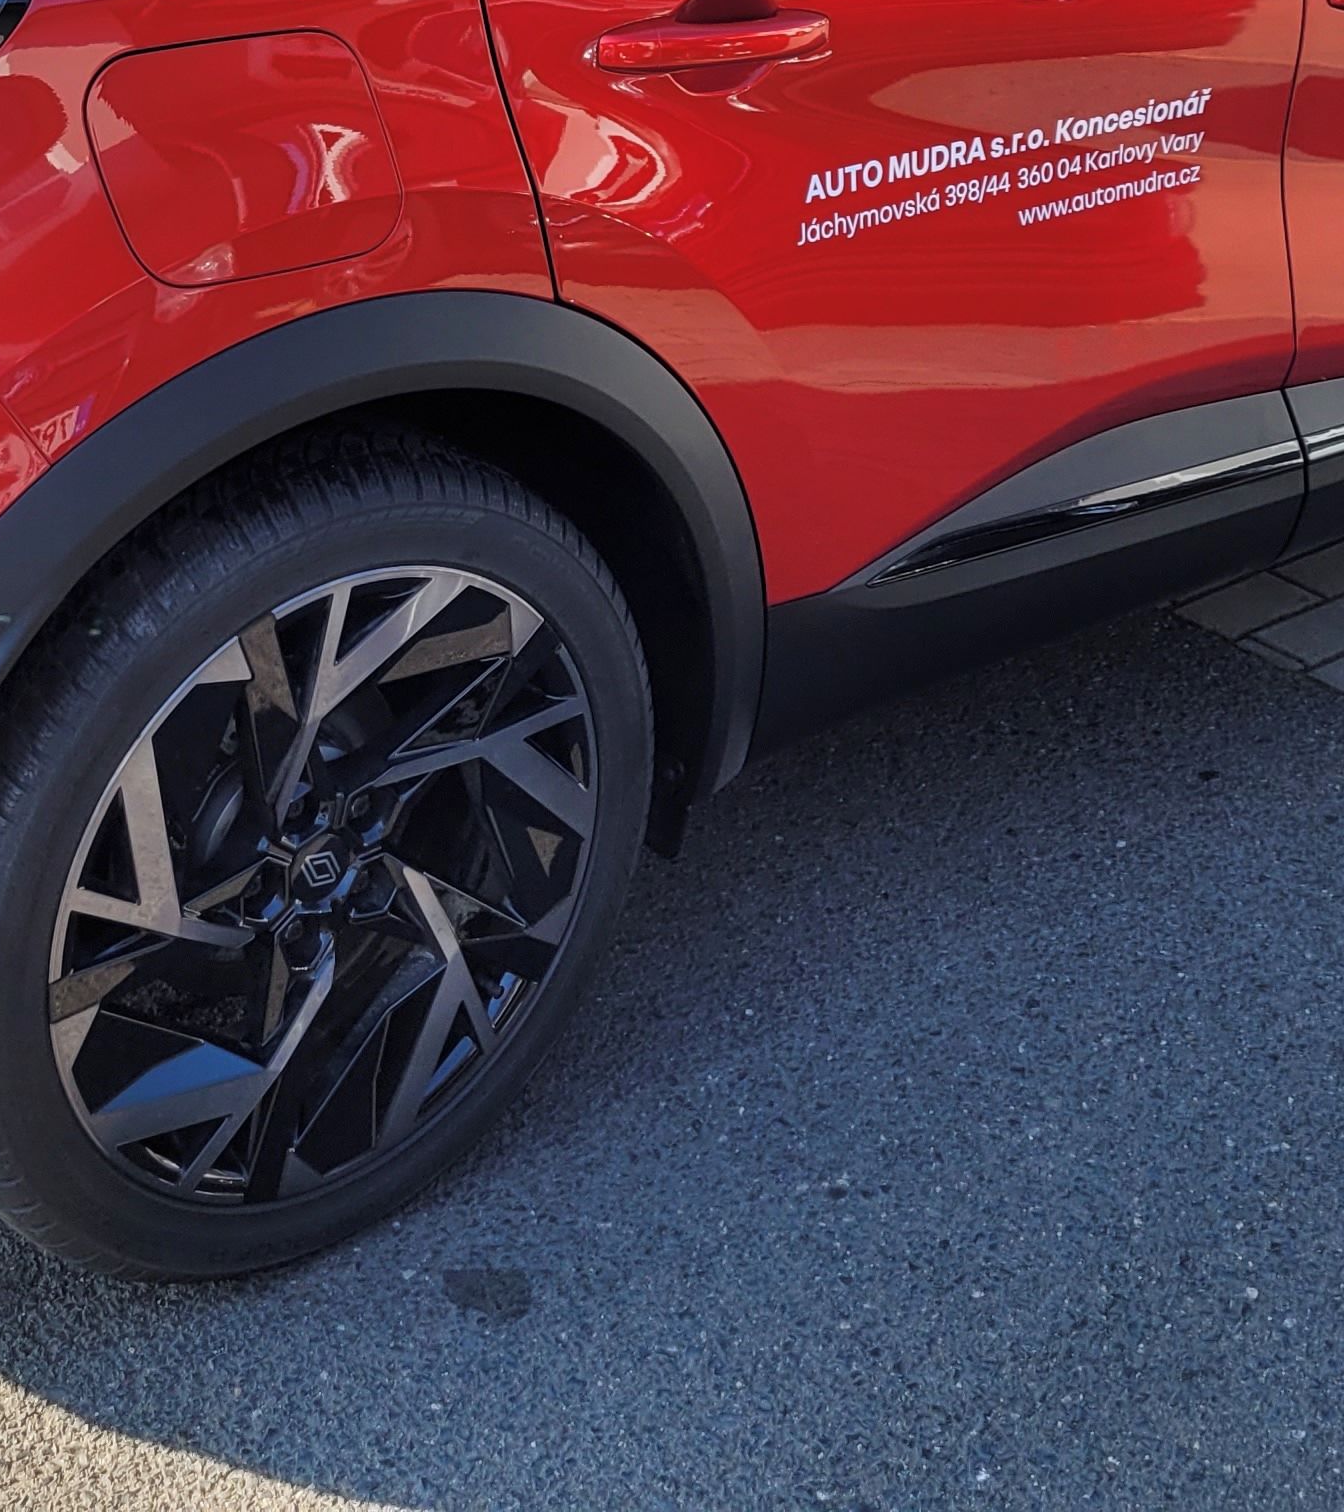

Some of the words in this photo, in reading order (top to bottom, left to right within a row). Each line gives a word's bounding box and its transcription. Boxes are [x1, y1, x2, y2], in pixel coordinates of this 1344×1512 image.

[797, 189, 941, 247] Jáchymovská
[945, 175, 1011, 207] 398/44
[1017, 165, 1054, 190] 360
[1056, 156, 1082, 180] 04
[1084, 139, 1158, 173] Karlovy
[1160, 129, 1206, 159] Vary
[805, 160, 884, 204] AUTO
[888, 137, 986, 184] MUDRA
[990, 128, 1050, 159] s.r.o.
[1055, 88, 1213, 144] Koncesionář
[1018, 164, 1201, 226] www.automudra.cz
